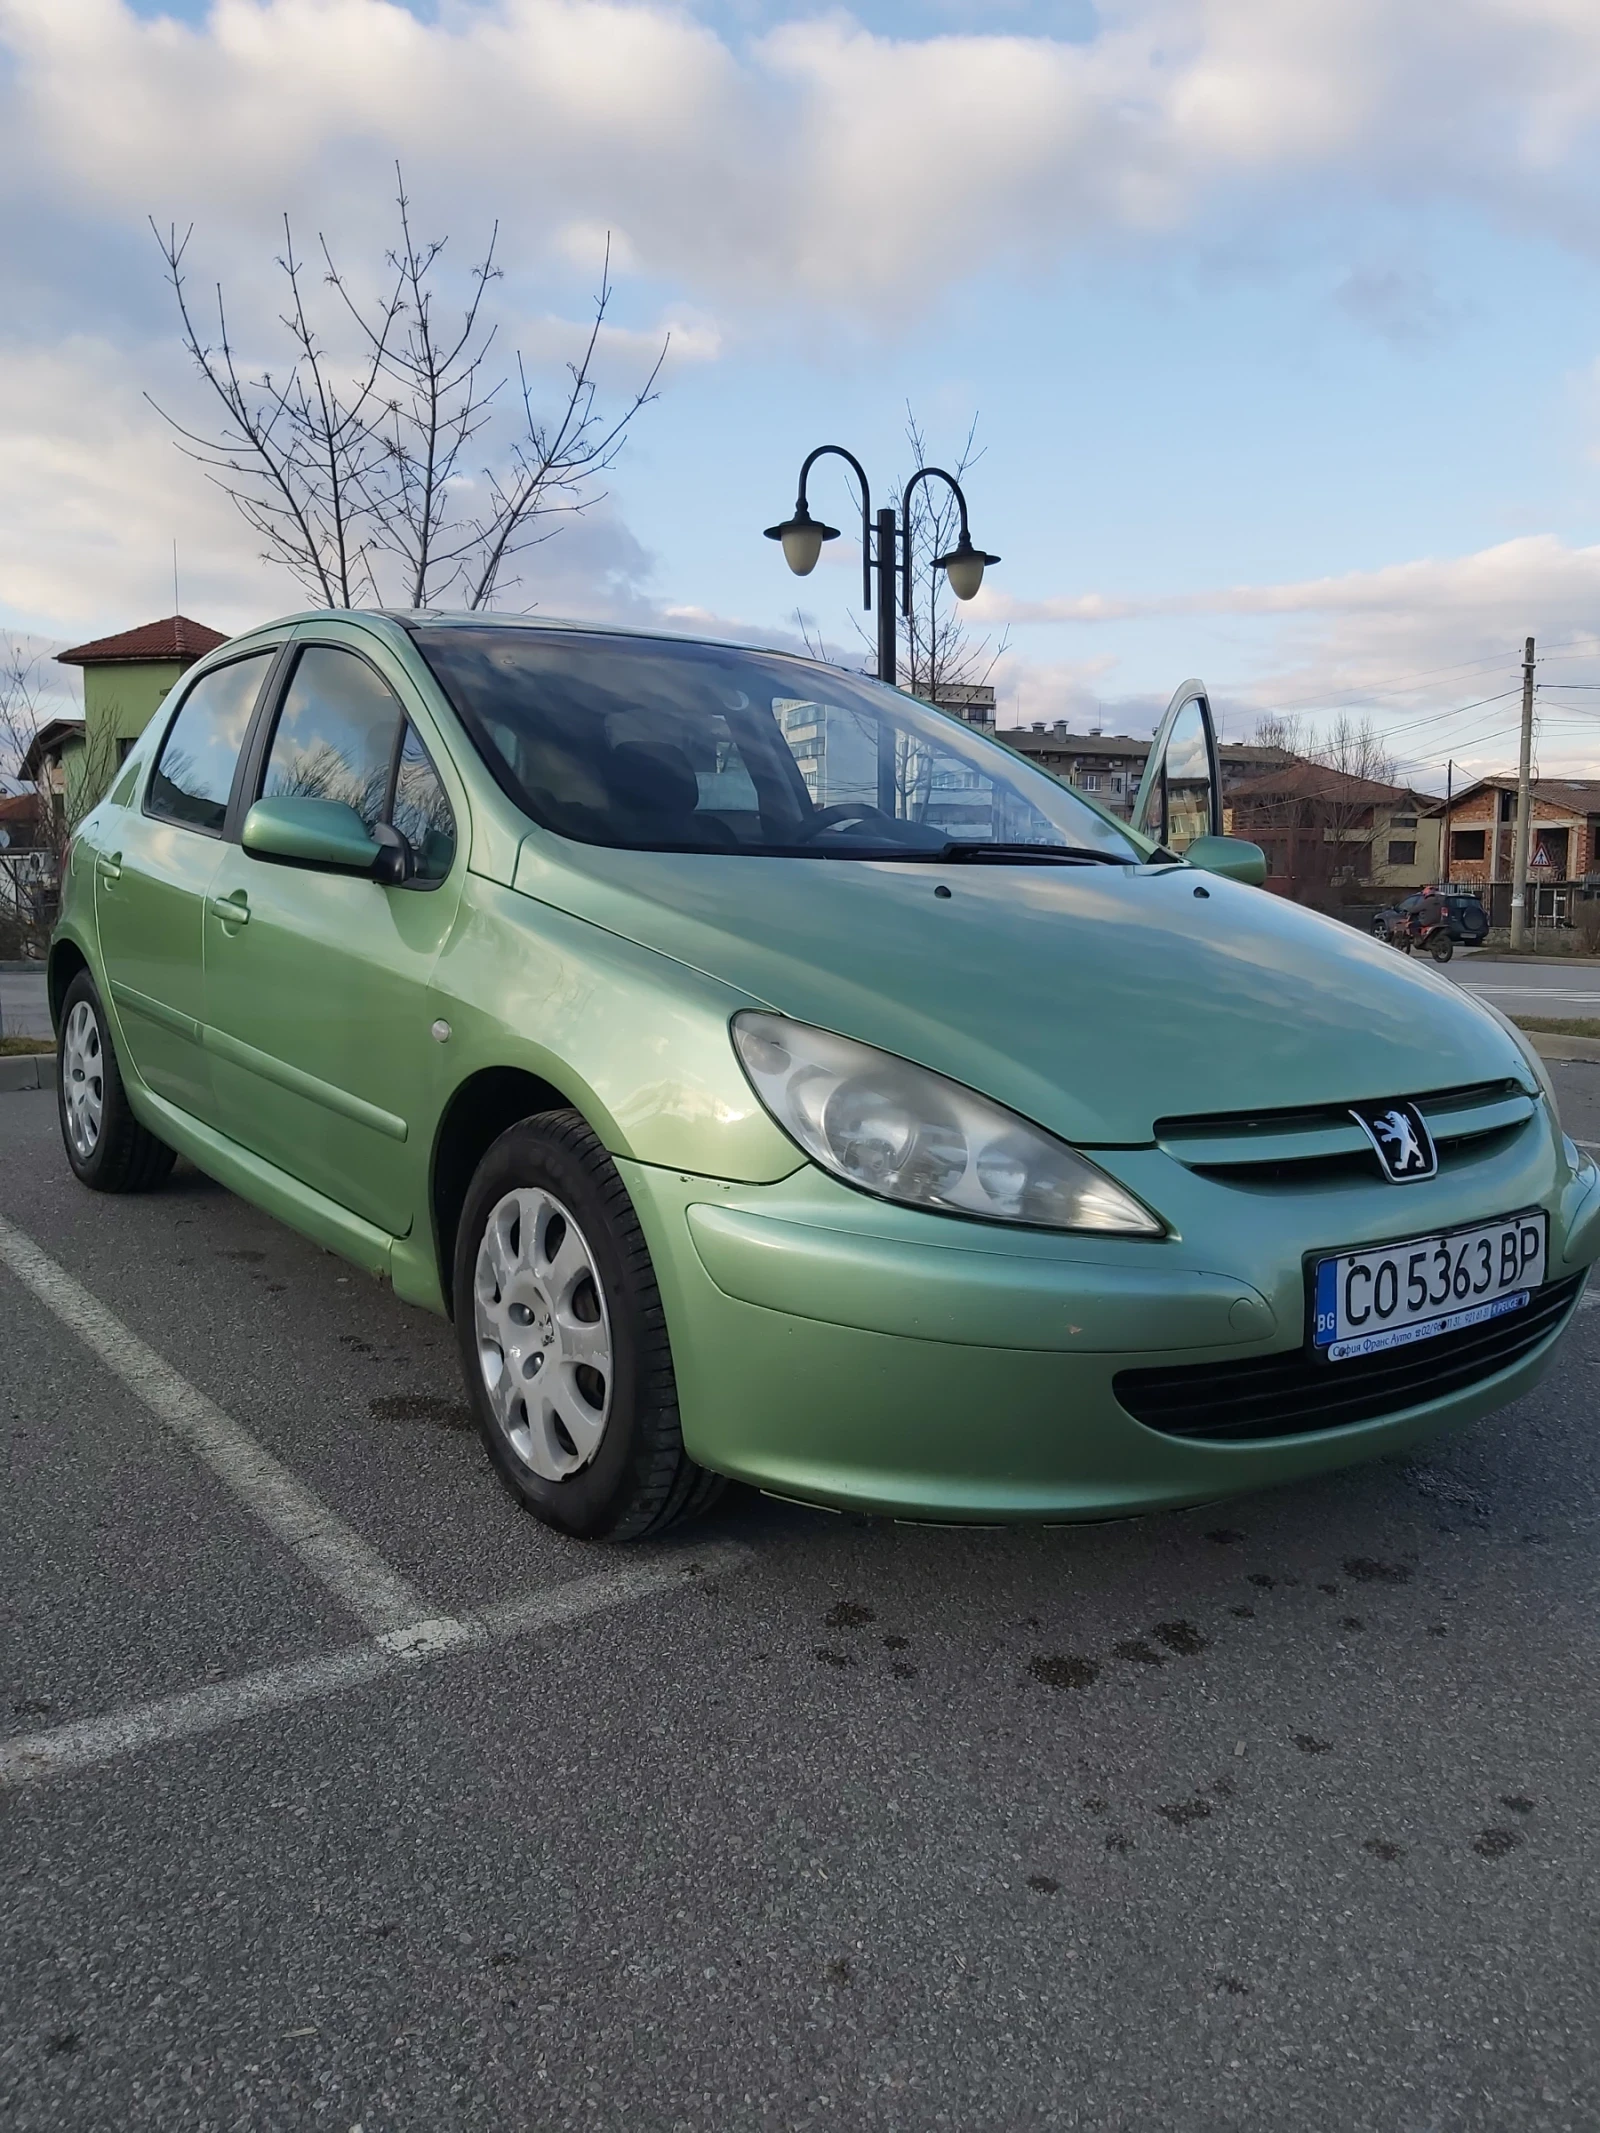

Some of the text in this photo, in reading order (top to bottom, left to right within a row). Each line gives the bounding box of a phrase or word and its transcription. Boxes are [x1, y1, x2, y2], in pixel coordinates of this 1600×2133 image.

[1407, 1238, 1491, 1311] 5363
[1497, 1295, 1526, 1309] PEUGET
[1317, 1312, 1335, 1332] BG
[1363, 1339, 1389, 1353] Франс
